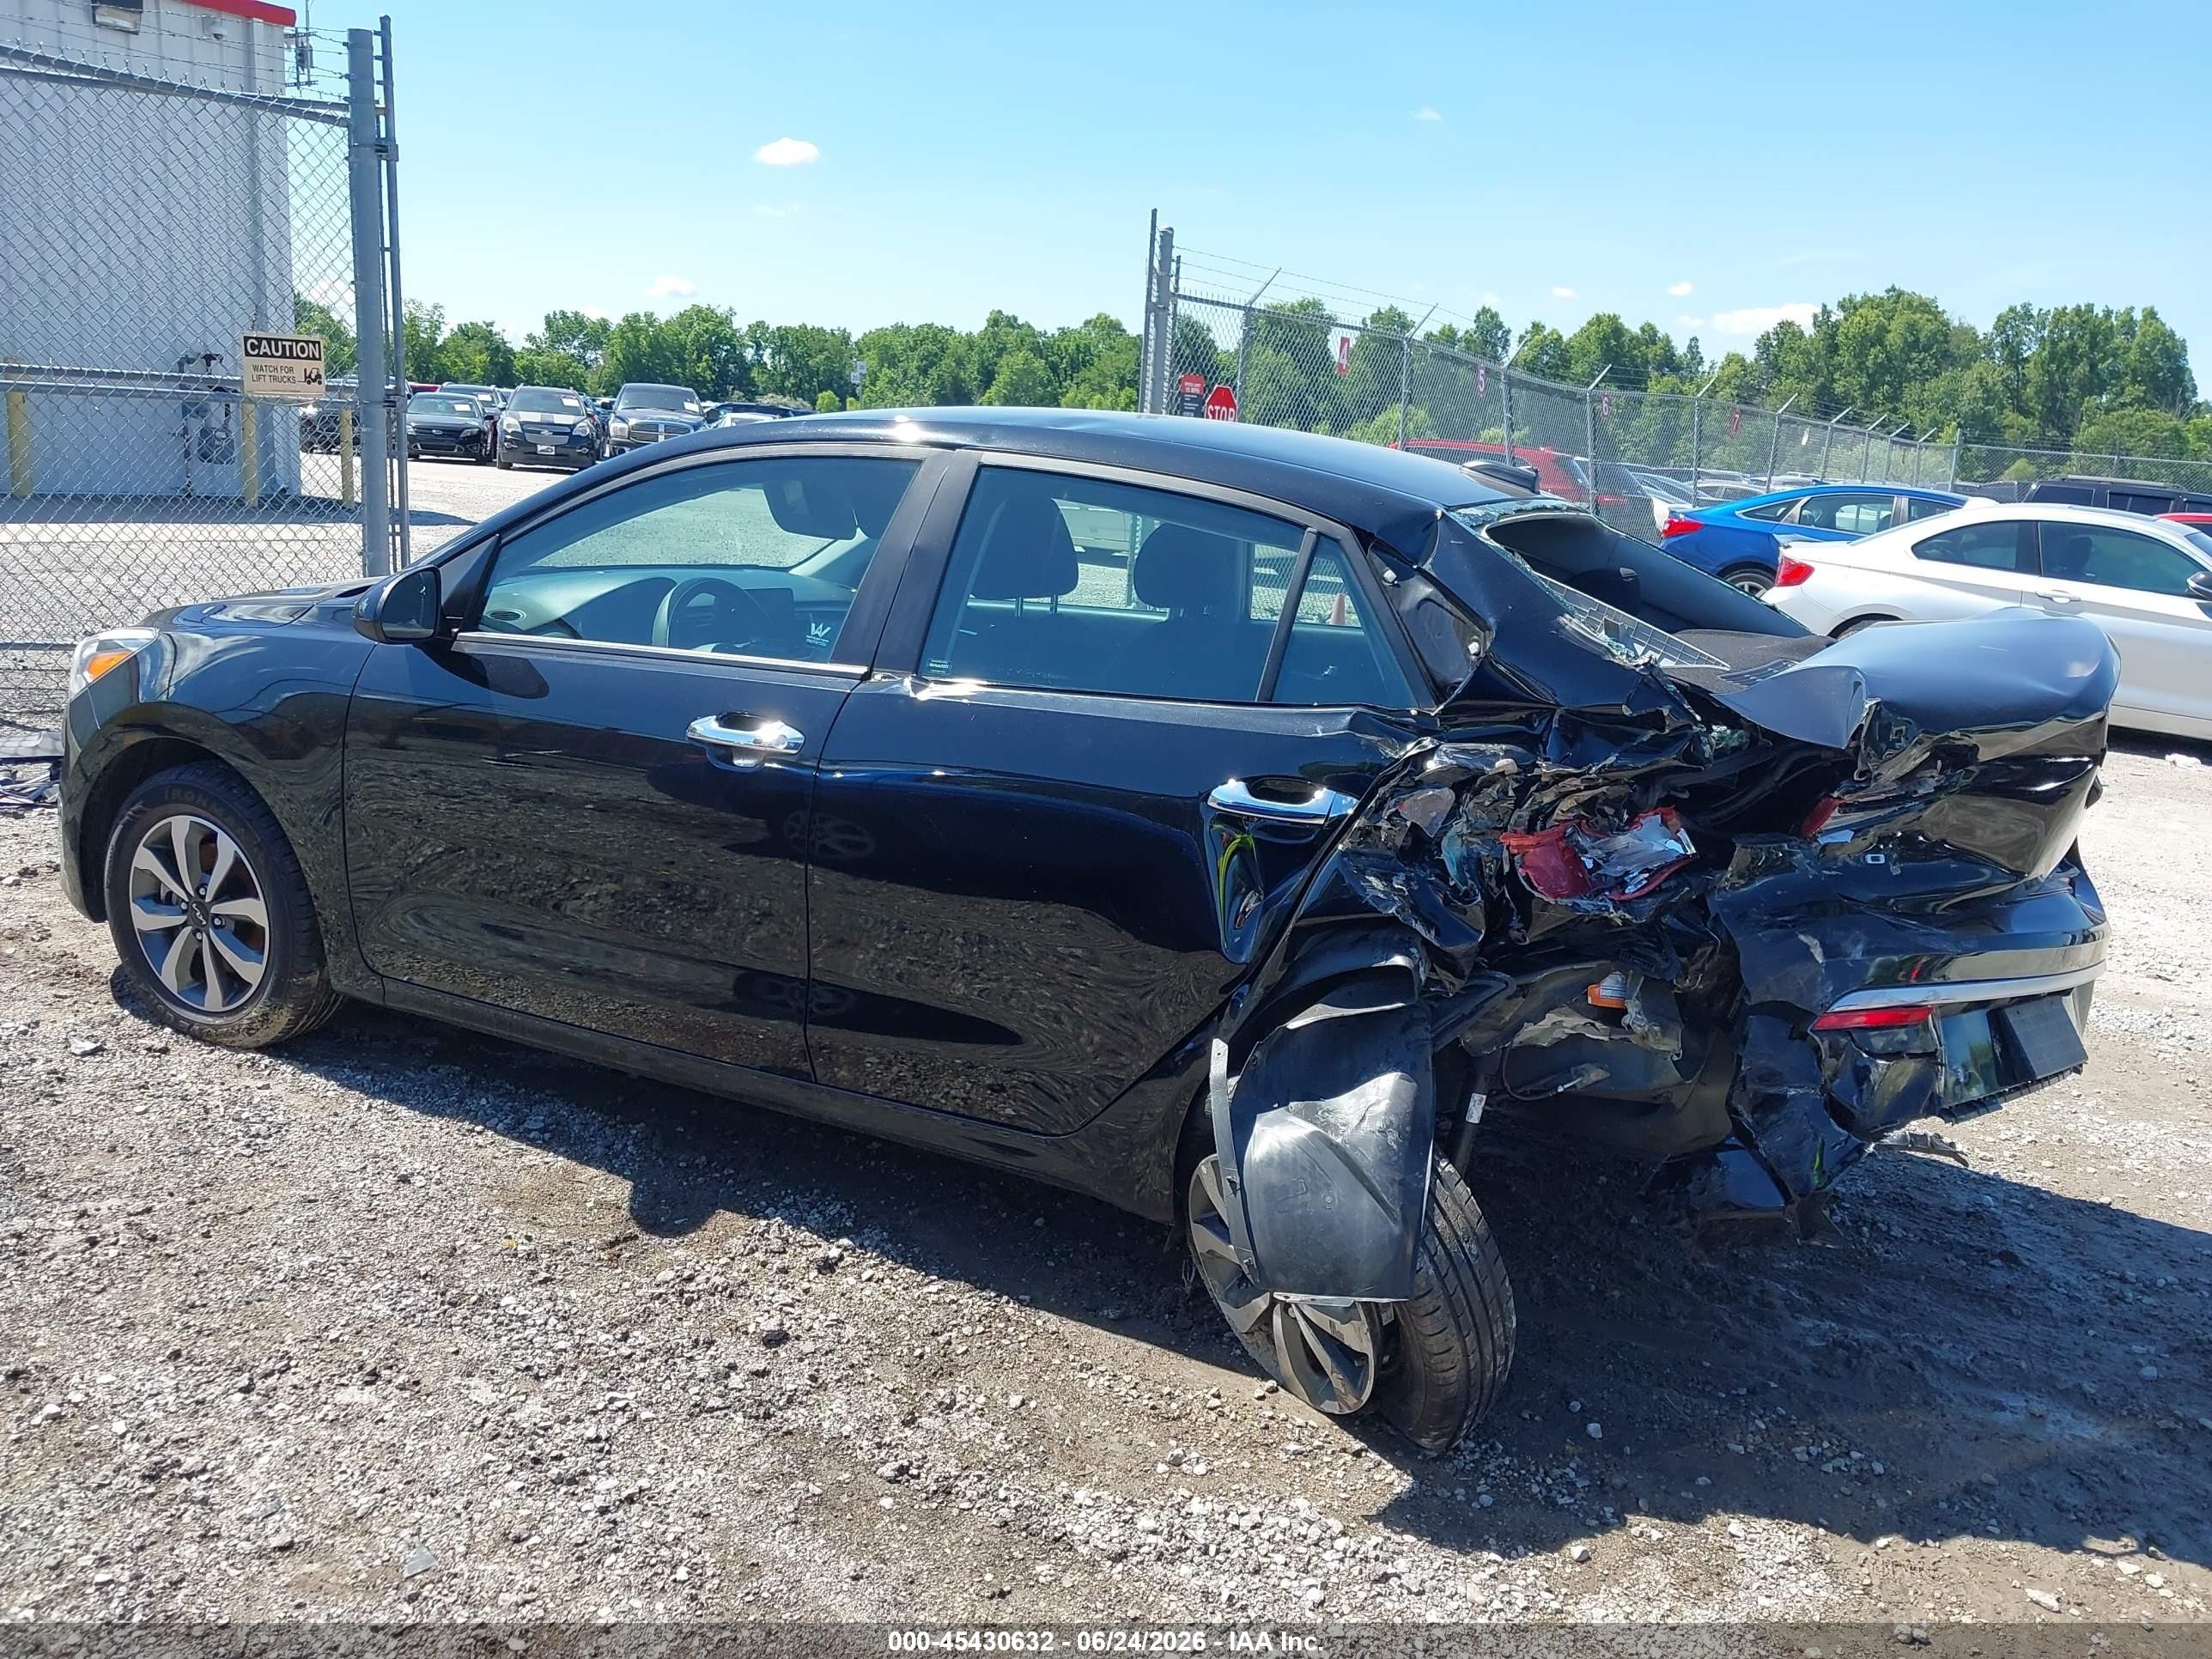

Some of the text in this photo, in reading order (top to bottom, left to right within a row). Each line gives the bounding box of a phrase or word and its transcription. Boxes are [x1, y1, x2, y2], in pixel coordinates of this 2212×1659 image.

[246, 338, 319, 359] CAUTION
[1340, 342, 1348, 369] 4
[252, 364, 295, 374] WATCH FOR
[252, 374, 296, 385] LIFT TRUCKS
[1478, 369, 1485, 392] 5
[1207, 404, 1236, 422] STOP
[1602, 396, 1609, 416] 6
